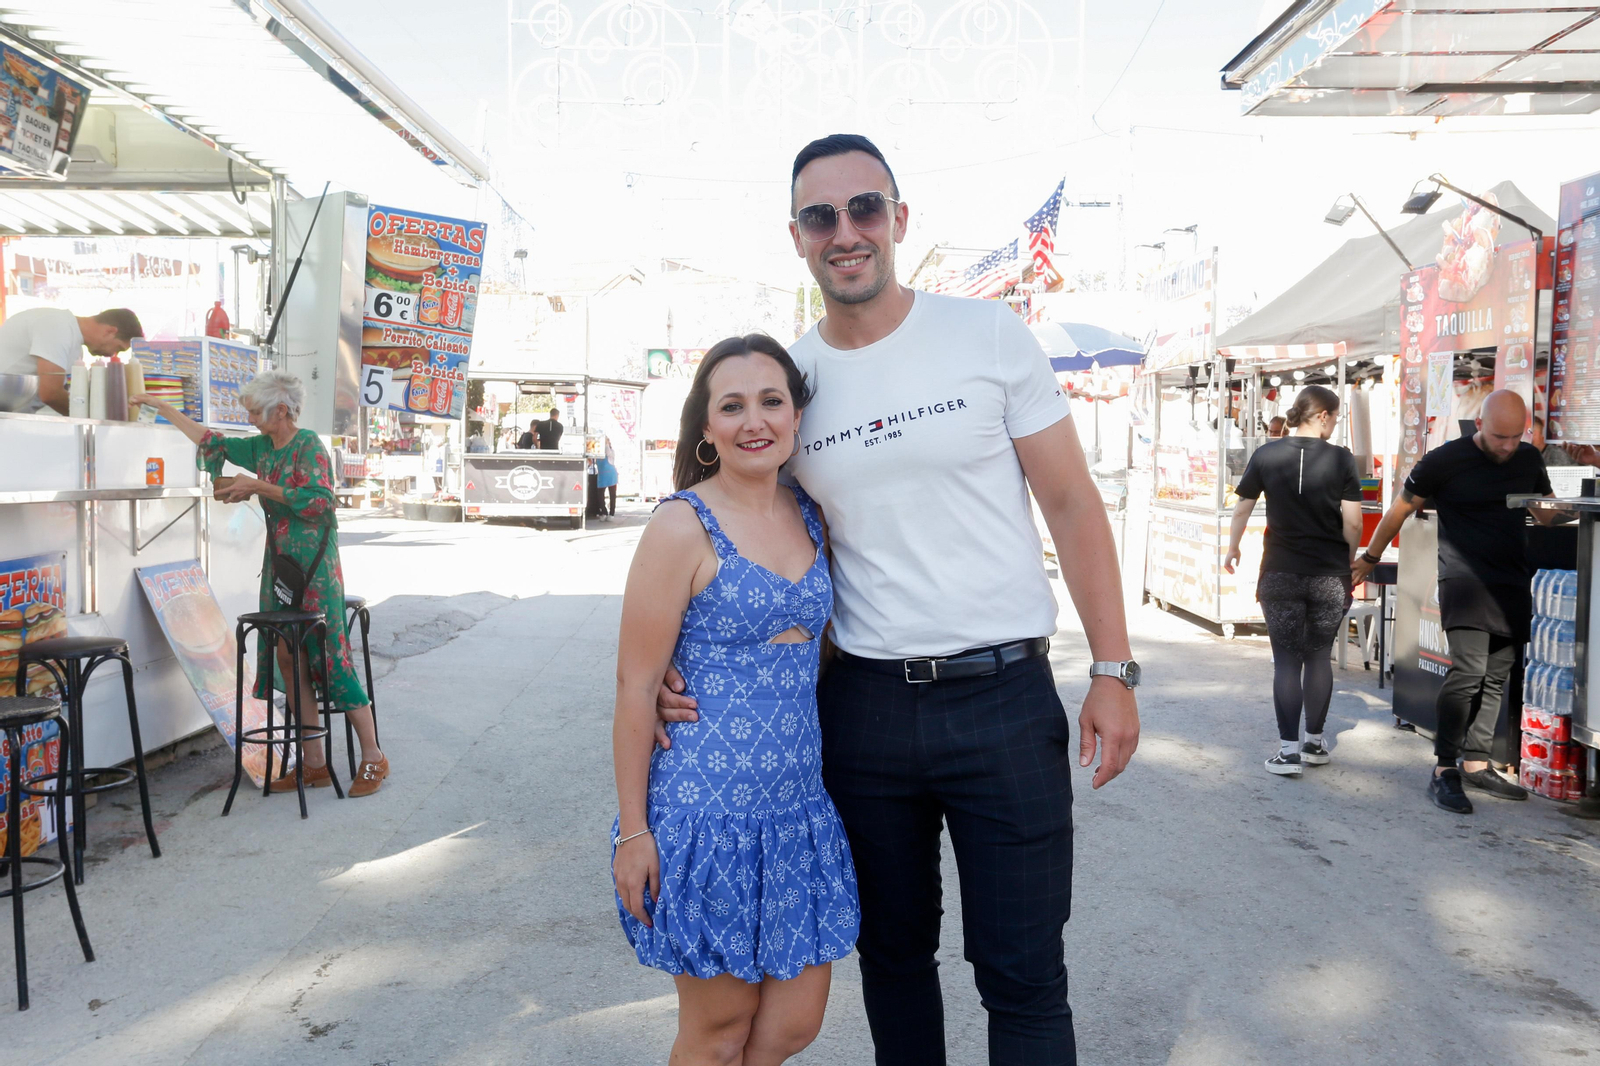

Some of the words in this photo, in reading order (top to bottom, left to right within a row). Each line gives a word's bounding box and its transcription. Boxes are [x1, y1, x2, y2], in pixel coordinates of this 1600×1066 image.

[25, 115, 51, 134] SAQUEN
[43, 139, 53, 149] EN
[370, 212, 484, 254] OFERTAS
[393, 238, 480, 267] Hamburguesa
[423, 273, 476, 294] Bebida
[373, 292, 393, 318] 6
[1435, 307, 1493, 337] TAQUILLA
[383, 328, 422, 347] Perrito
[425, 334, 469, 355] Caliente
[412, 361, 465, 381] Bebida
[364, 369, 384, 405] 5
[804, 425, 863, 455] TOMMY
[887, 398, 967, 426] HILFIGER
[864, 436, 882, 448] EST.
[884, 429, 903, 442] 1985
[144, 564, 210, 612] MENÚ
[1418, 618, 1442, 653] HNOS.
[1418, 657, 1438, 674] PATATAS
[1438, 665, 1448, 677] AS
